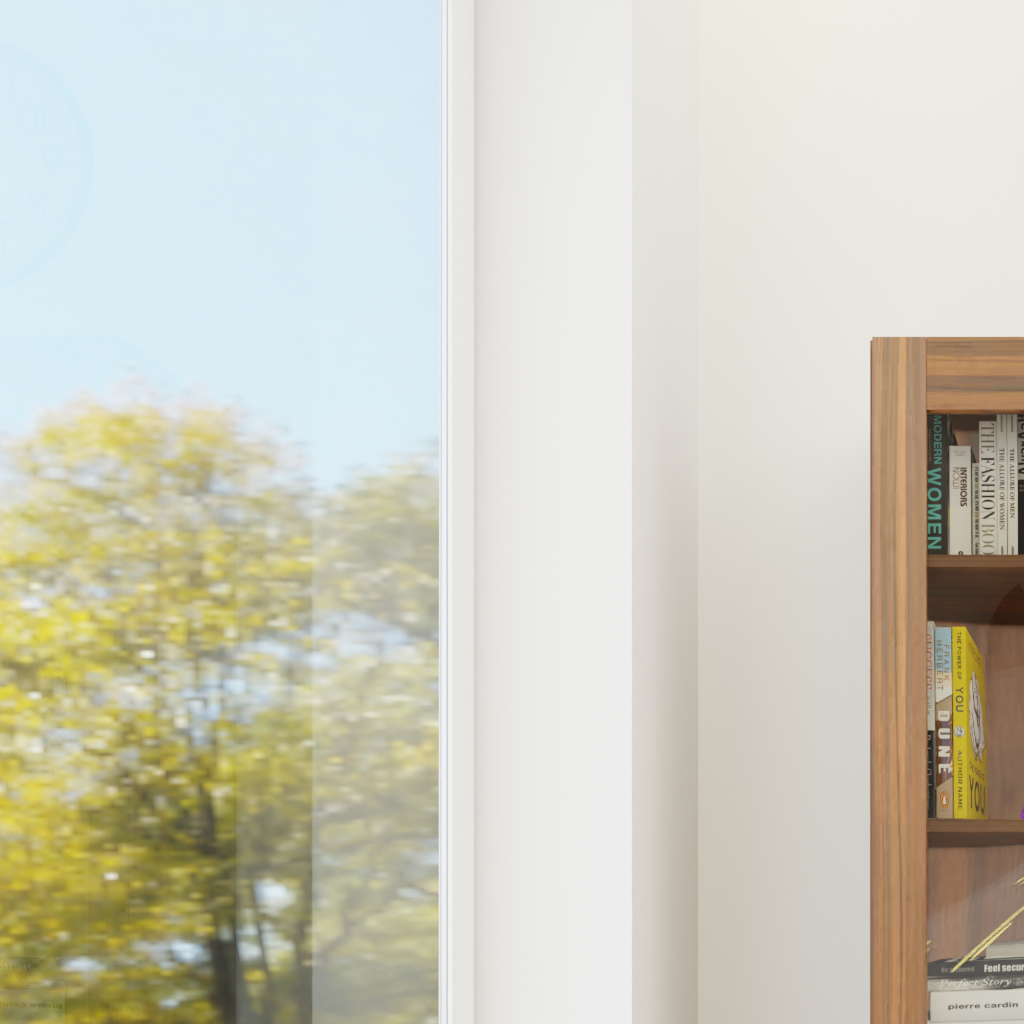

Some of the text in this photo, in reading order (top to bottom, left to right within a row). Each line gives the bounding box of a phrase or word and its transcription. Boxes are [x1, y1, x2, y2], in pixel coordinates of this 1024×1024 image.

[981, 423, 995, 453] THE
[927, 415, 942, 549] MODERN WOMEN
[981, 457, 995, 520] FASHION
[999, 492, 1005, 502] OF
[1010, 492, 1015, 501] OF
[957, 672, 962, 680] OF
[955, 687, 964, 712] YOU
[938, 710, 951, 774] DUNE
[969, 774, 986, 816] YOU
[984, 964, 1000, 972] Feel
[939, 978, 1012, 987] Perfect Story
